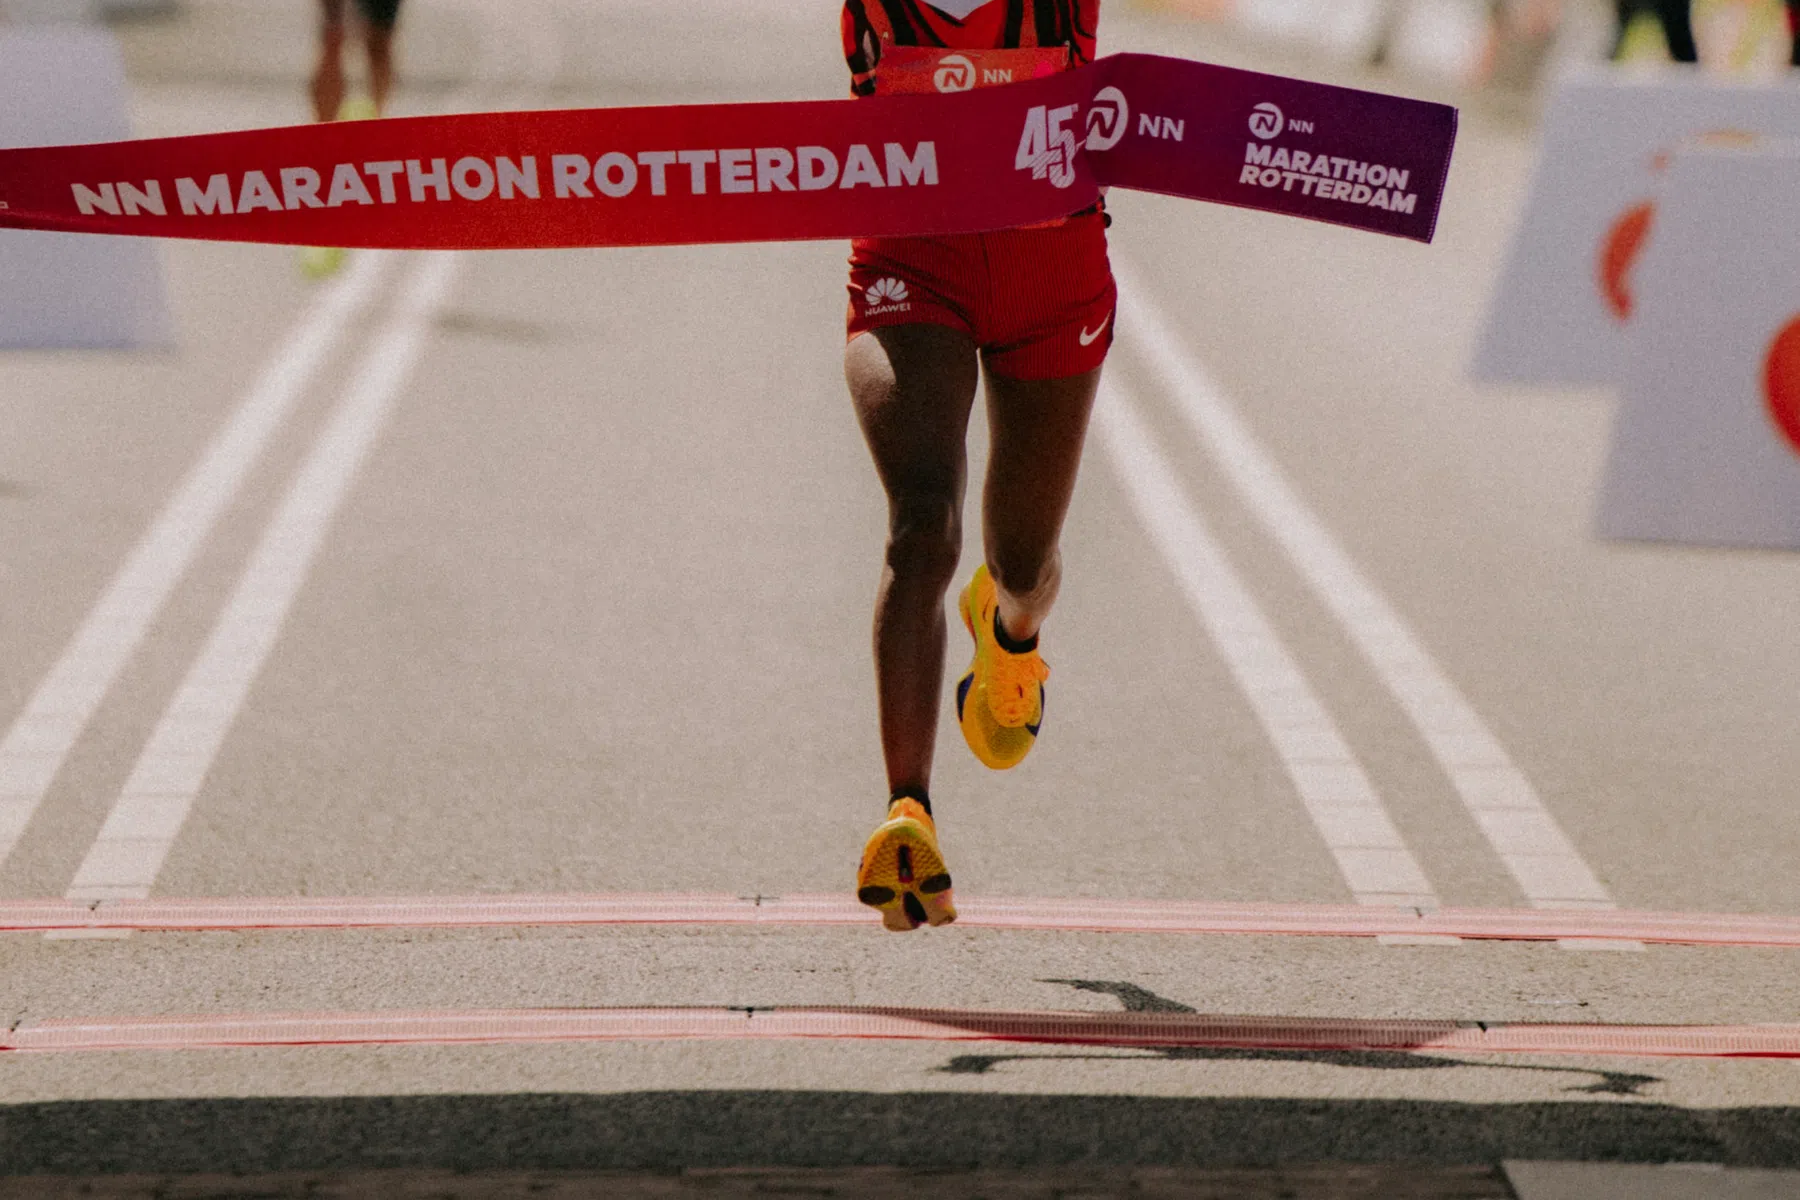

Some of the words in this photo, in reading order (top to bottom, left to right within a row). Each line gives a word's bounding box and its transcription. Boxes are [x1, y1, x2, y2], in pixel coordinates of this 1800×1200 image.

[983, 69, 1012, 83] NN
[1138, 112, 1185, 142] NN
[1288, 119, 1315, 135] NN
[71, 179, 167, 216] NN
[175, 155, 541, 216] MARATHON
[551, 141, 940, 199] ROTTERDAM
[1244, 142, 1410, 190] MARATHON
[1239, 164, 1417, 215] ROTTERDAM
[865, 303, 911, 317] HUAWEI
